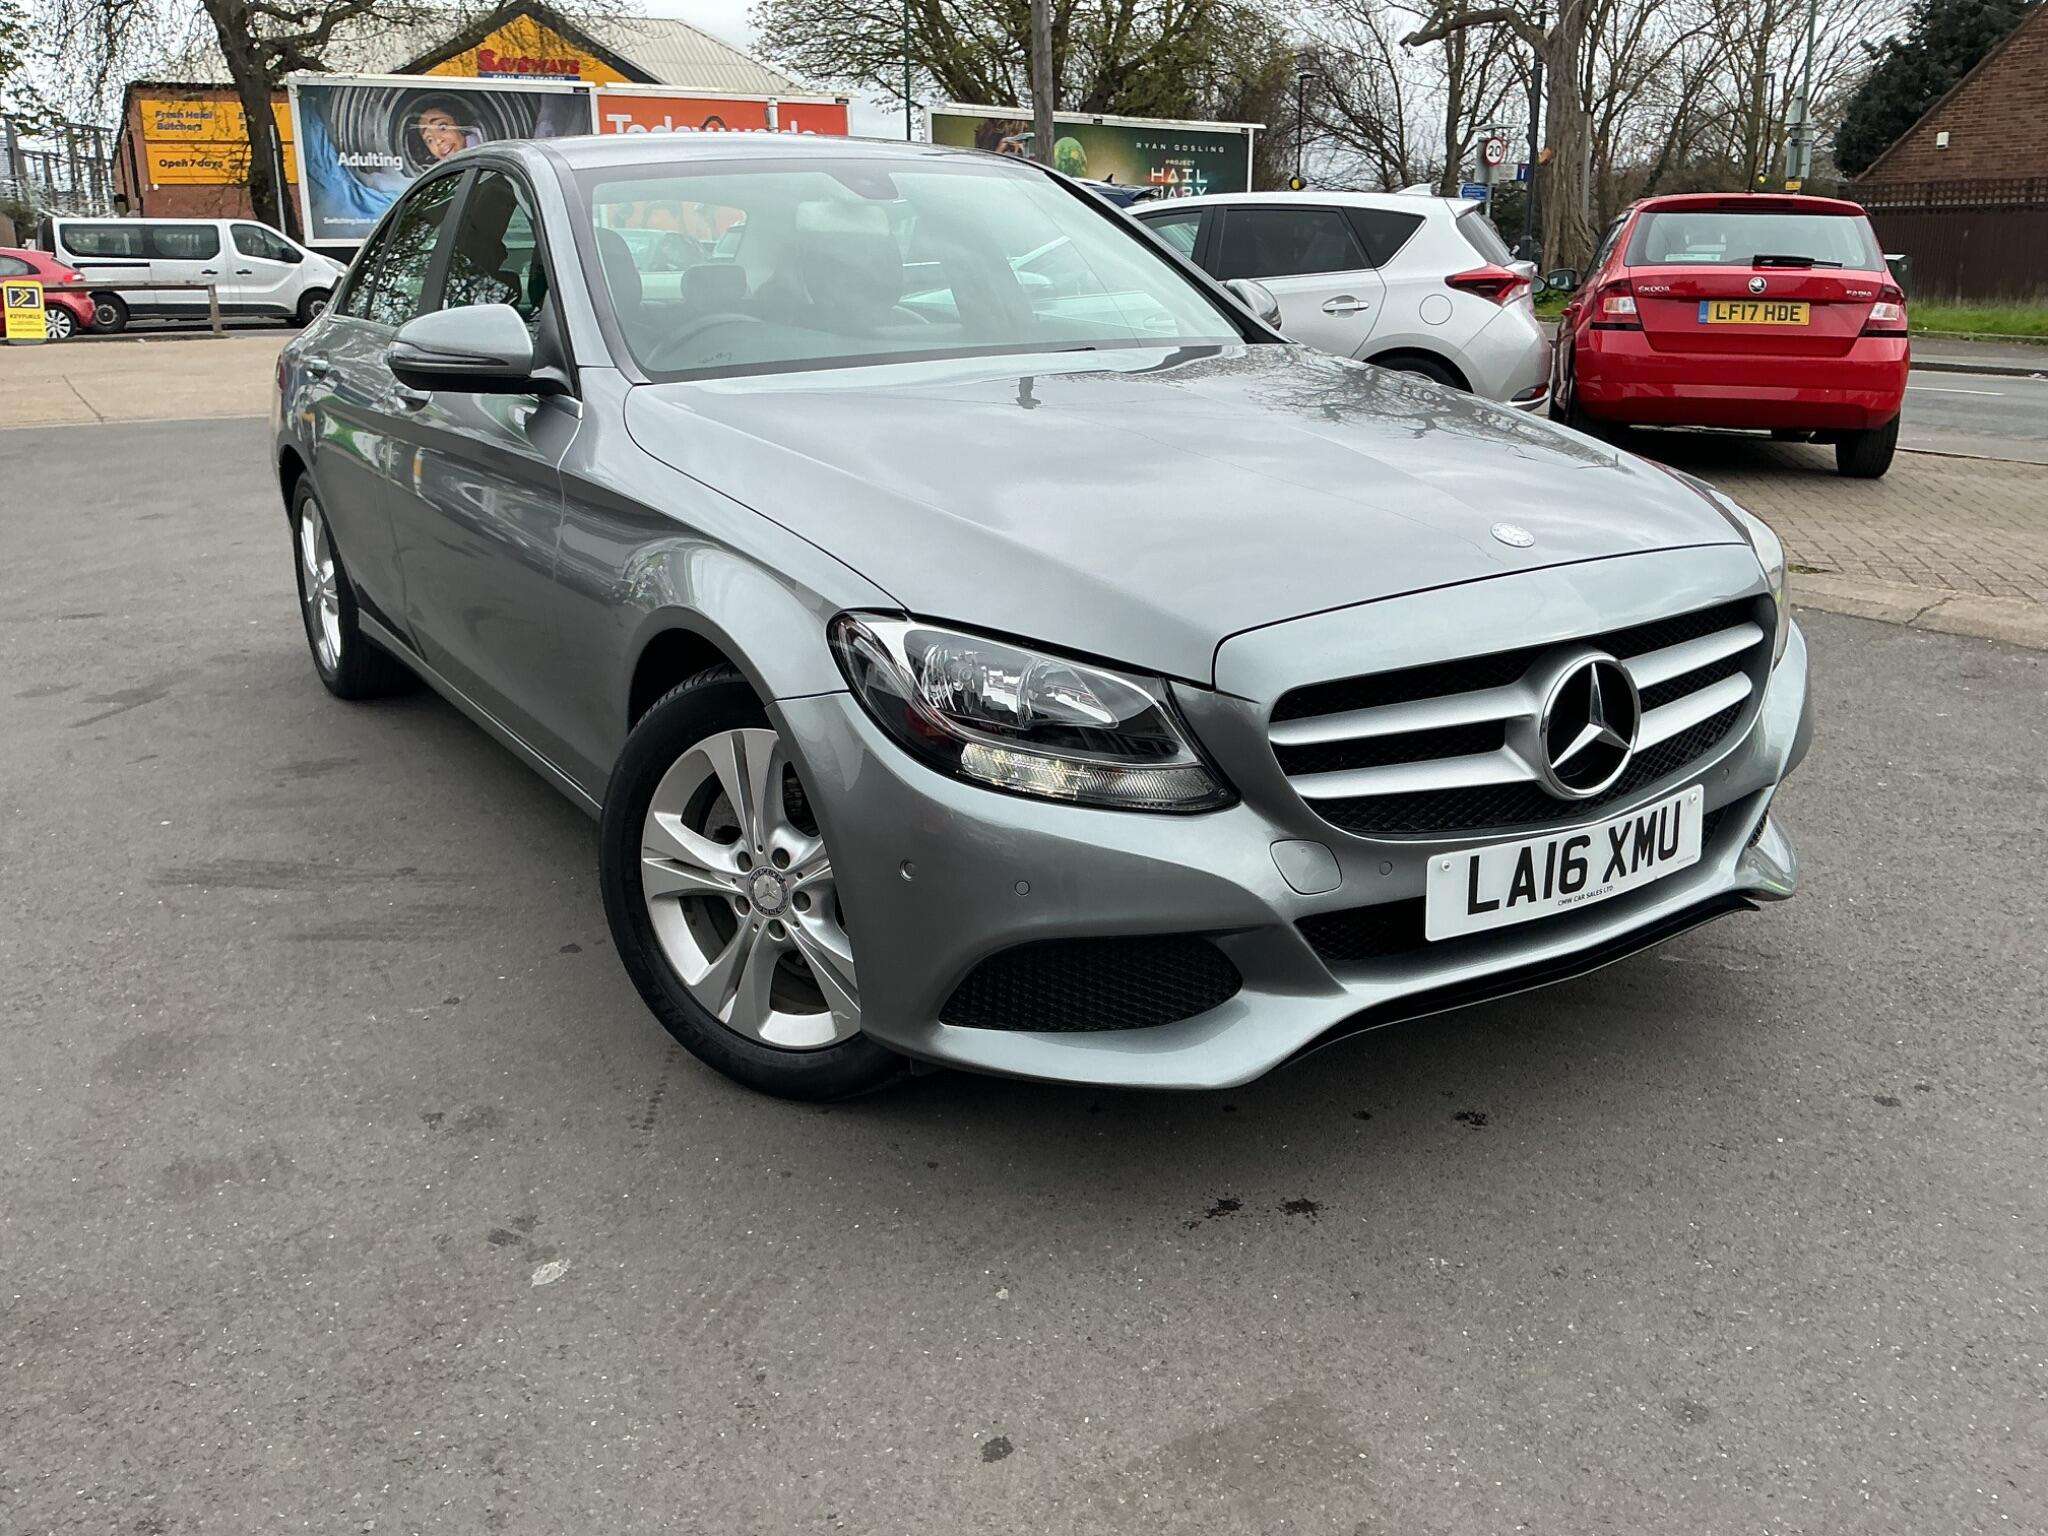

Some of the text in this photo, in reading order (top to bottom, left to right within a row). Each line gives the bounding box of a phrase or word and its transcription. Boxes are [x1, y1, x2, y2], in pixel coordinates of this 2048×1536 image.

[1135, 142, 1225, 153] RYAN GOSLING
[1488, 145, 1501, 157] 20
[159, 159, 188, 169] Open
[190, 159, 196, 168] 7
[338, 152, 403, 171] Adulting
[1150, 167, 1208, 184] HAIL
[1716, 303, 1802, 322] LF17 HDE
[1467, 801, 1681, 915] LA16 XMU
[1574, 893, 1585, 902] CAR
[1586, 889, 1603, 899] SALES
[1603, 885, 1613, 893] LTD
